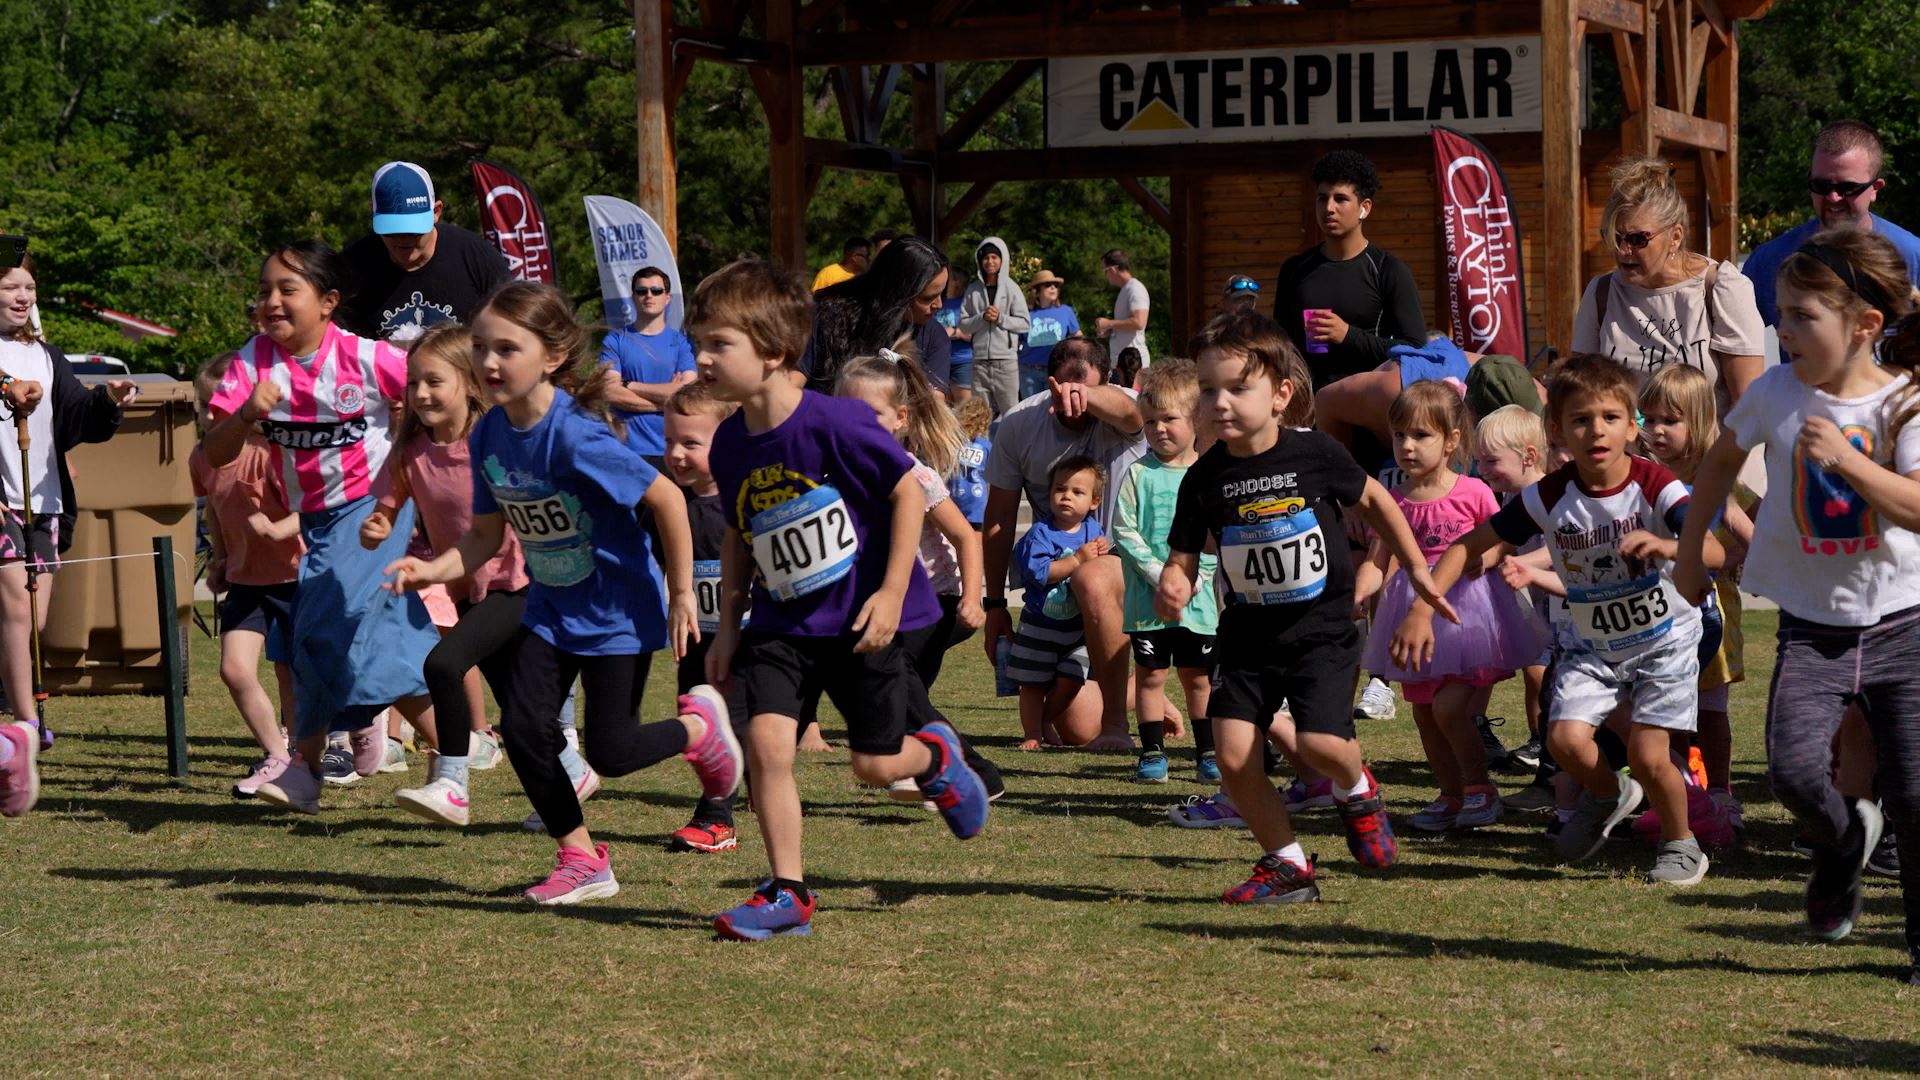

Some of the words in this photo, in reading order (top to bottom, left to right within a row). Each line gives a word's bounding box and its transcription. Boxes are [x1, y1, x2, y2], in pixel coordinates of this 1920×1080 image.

[1099, 47, 1514, 131] CATERPILLAR
[598, 223, 645, 244] SENIOR
[1444, 204, 1456, 252] PARKS
[1484, 195, 1517, 297] Think
[601, 241, 648, 263] GAMES
[1447, 255, 1458, 269] &
[1449, 272, 1465, 350] RECREATIO
[1638, 315, 1657, 339] it
[1661, 317, 1682, 340] is
[1222, 472, 1298, 498] CHOOSE
[506, 500, 571, 536] 056
[1553, 523, 1610, 551] Mountain
[1612, 511, 1646, 539] Park
[770, 507, 854, 575] 4072
[1244, 532, 1325, 586] 4073
[1801, 535, 1880, 557] LOVE
[1591, 587, 1669, 635] 4053
